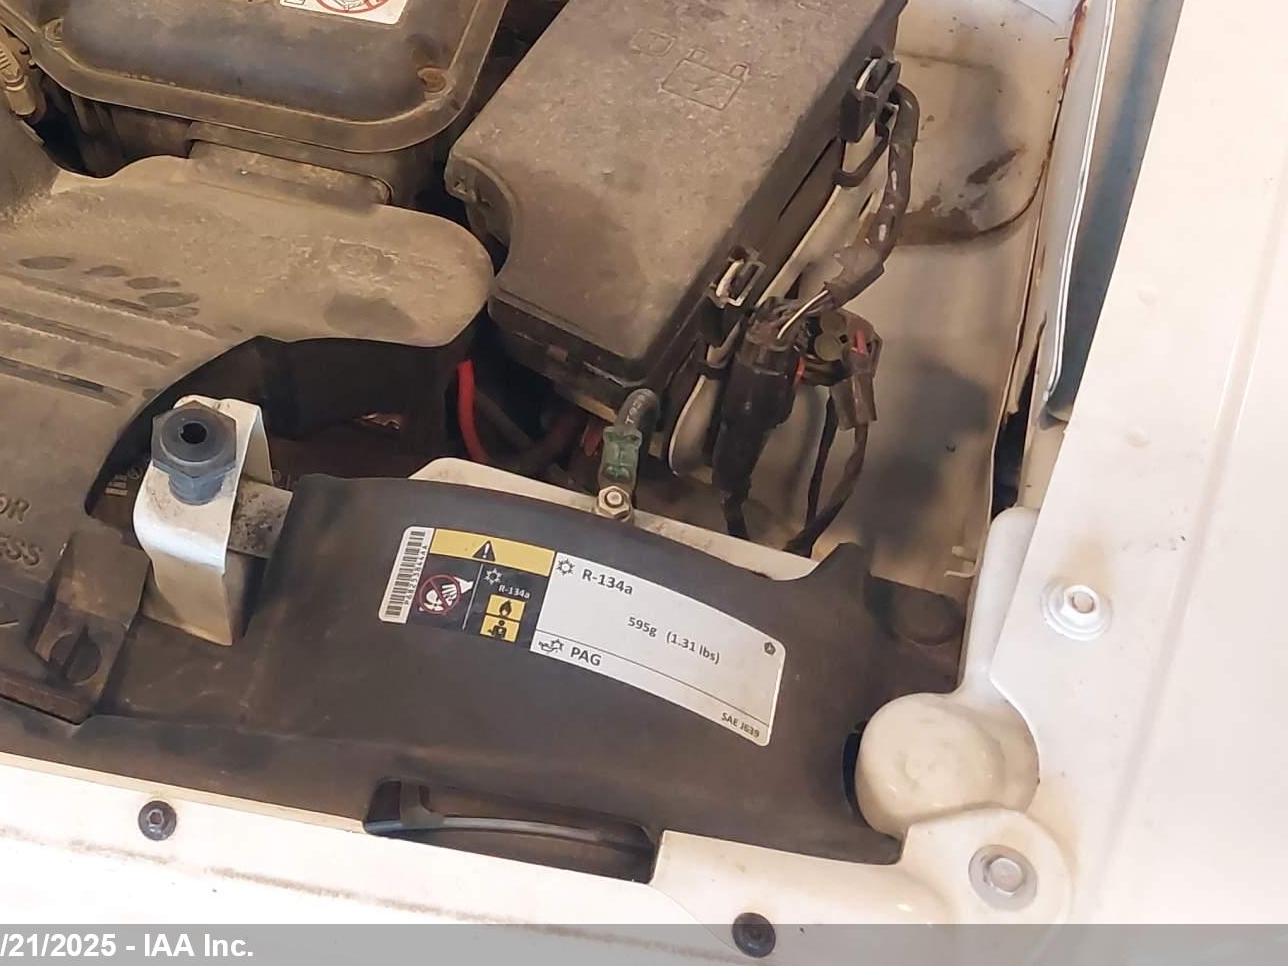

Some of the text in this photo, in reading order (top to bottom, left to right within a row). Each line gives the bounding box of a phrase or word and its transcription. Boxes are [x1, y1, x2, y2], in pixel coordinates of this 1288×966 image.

[498, 585, 530, 599] R-134a
[581, 567, 633, 595] R-134a
[628, 616, 720, 665] 595g (1.31 lbs)
[570, 647, 601, 667] PAG
[721, 712, 760, 738] SAE J639
